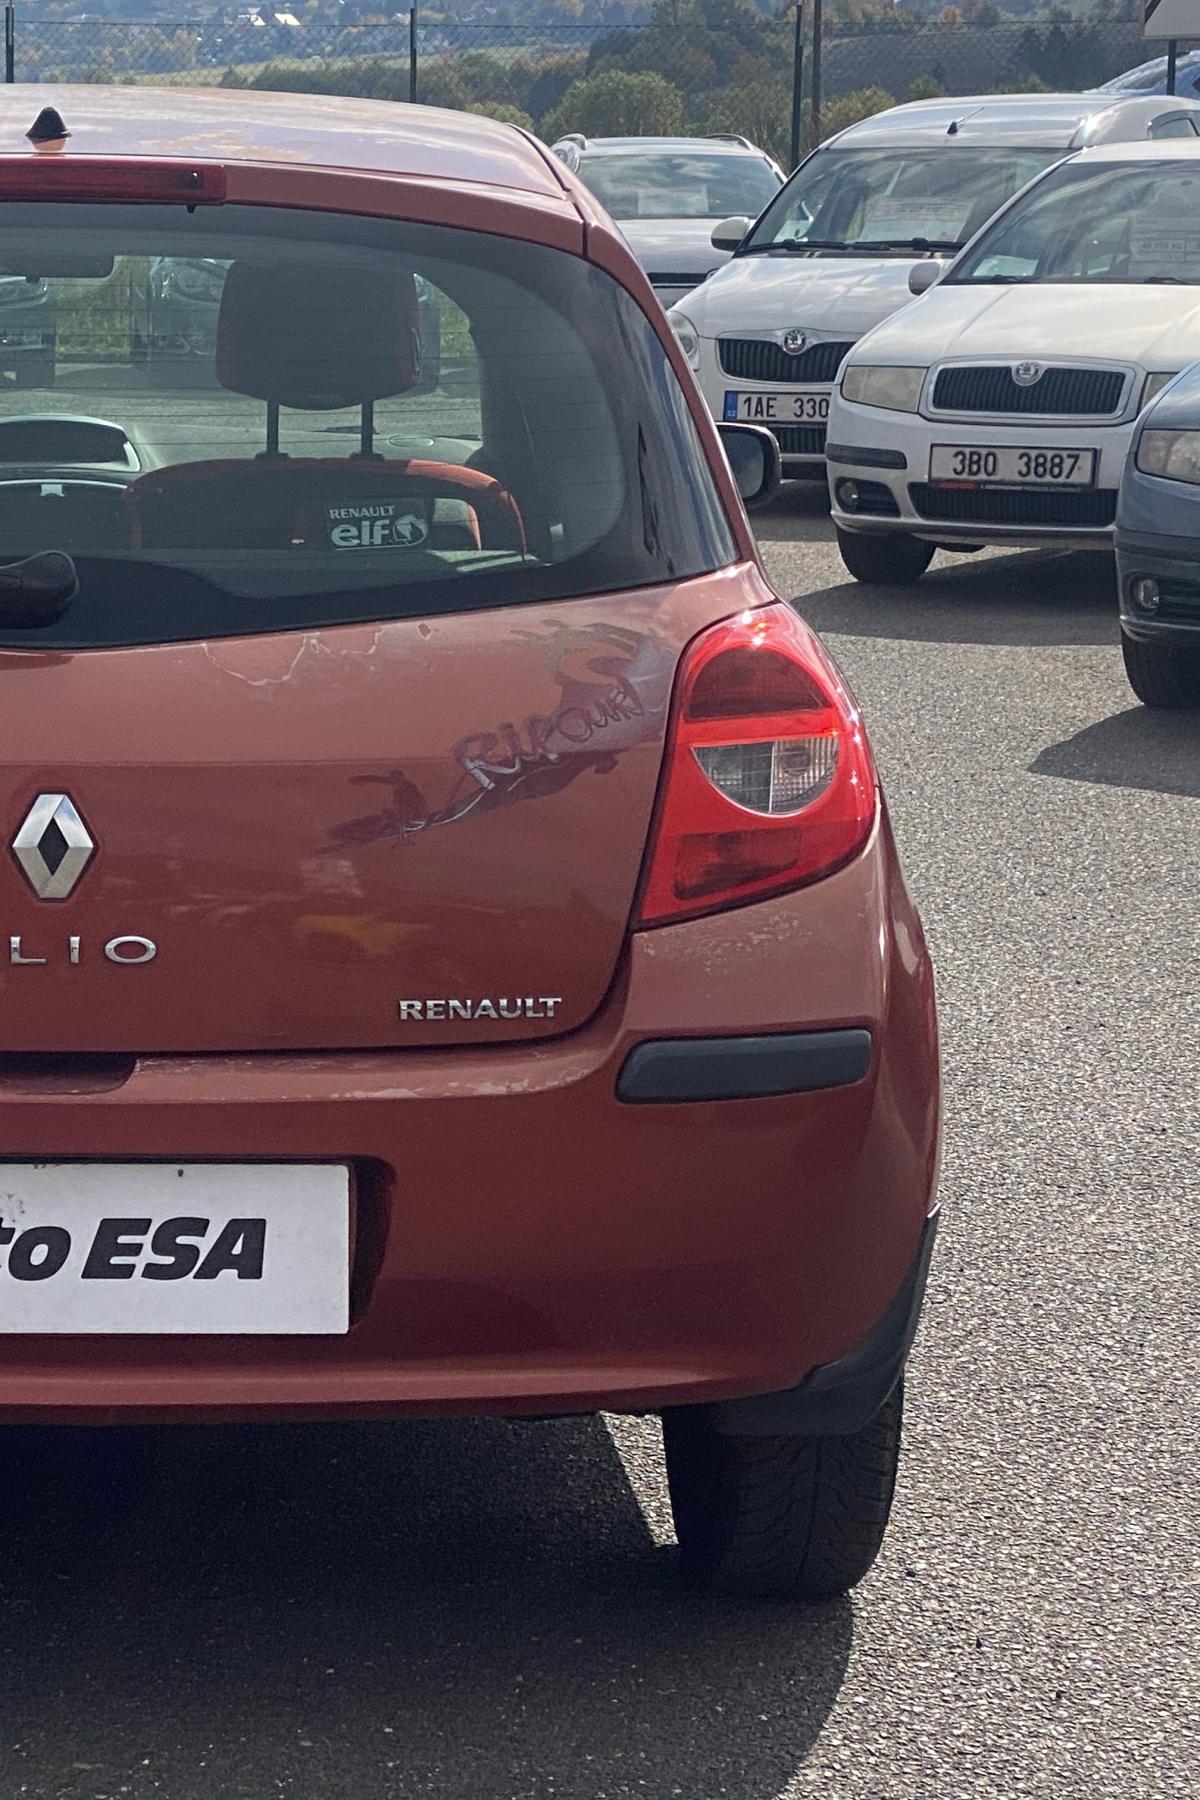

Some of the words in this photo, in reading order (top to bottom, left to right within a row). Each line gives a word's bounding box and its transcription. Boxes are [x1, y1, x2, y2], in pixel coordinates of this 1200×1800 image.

[744, 396, 777, 417] 1AE
[1017, 452, 1080, 479] 3887
[329, 505, 395, 519] RENAULT
[331, 520, 390, 547] elf
[399, 996, 563, 1020] RENAULT
[81, 1215, 267, 1282] ESA
